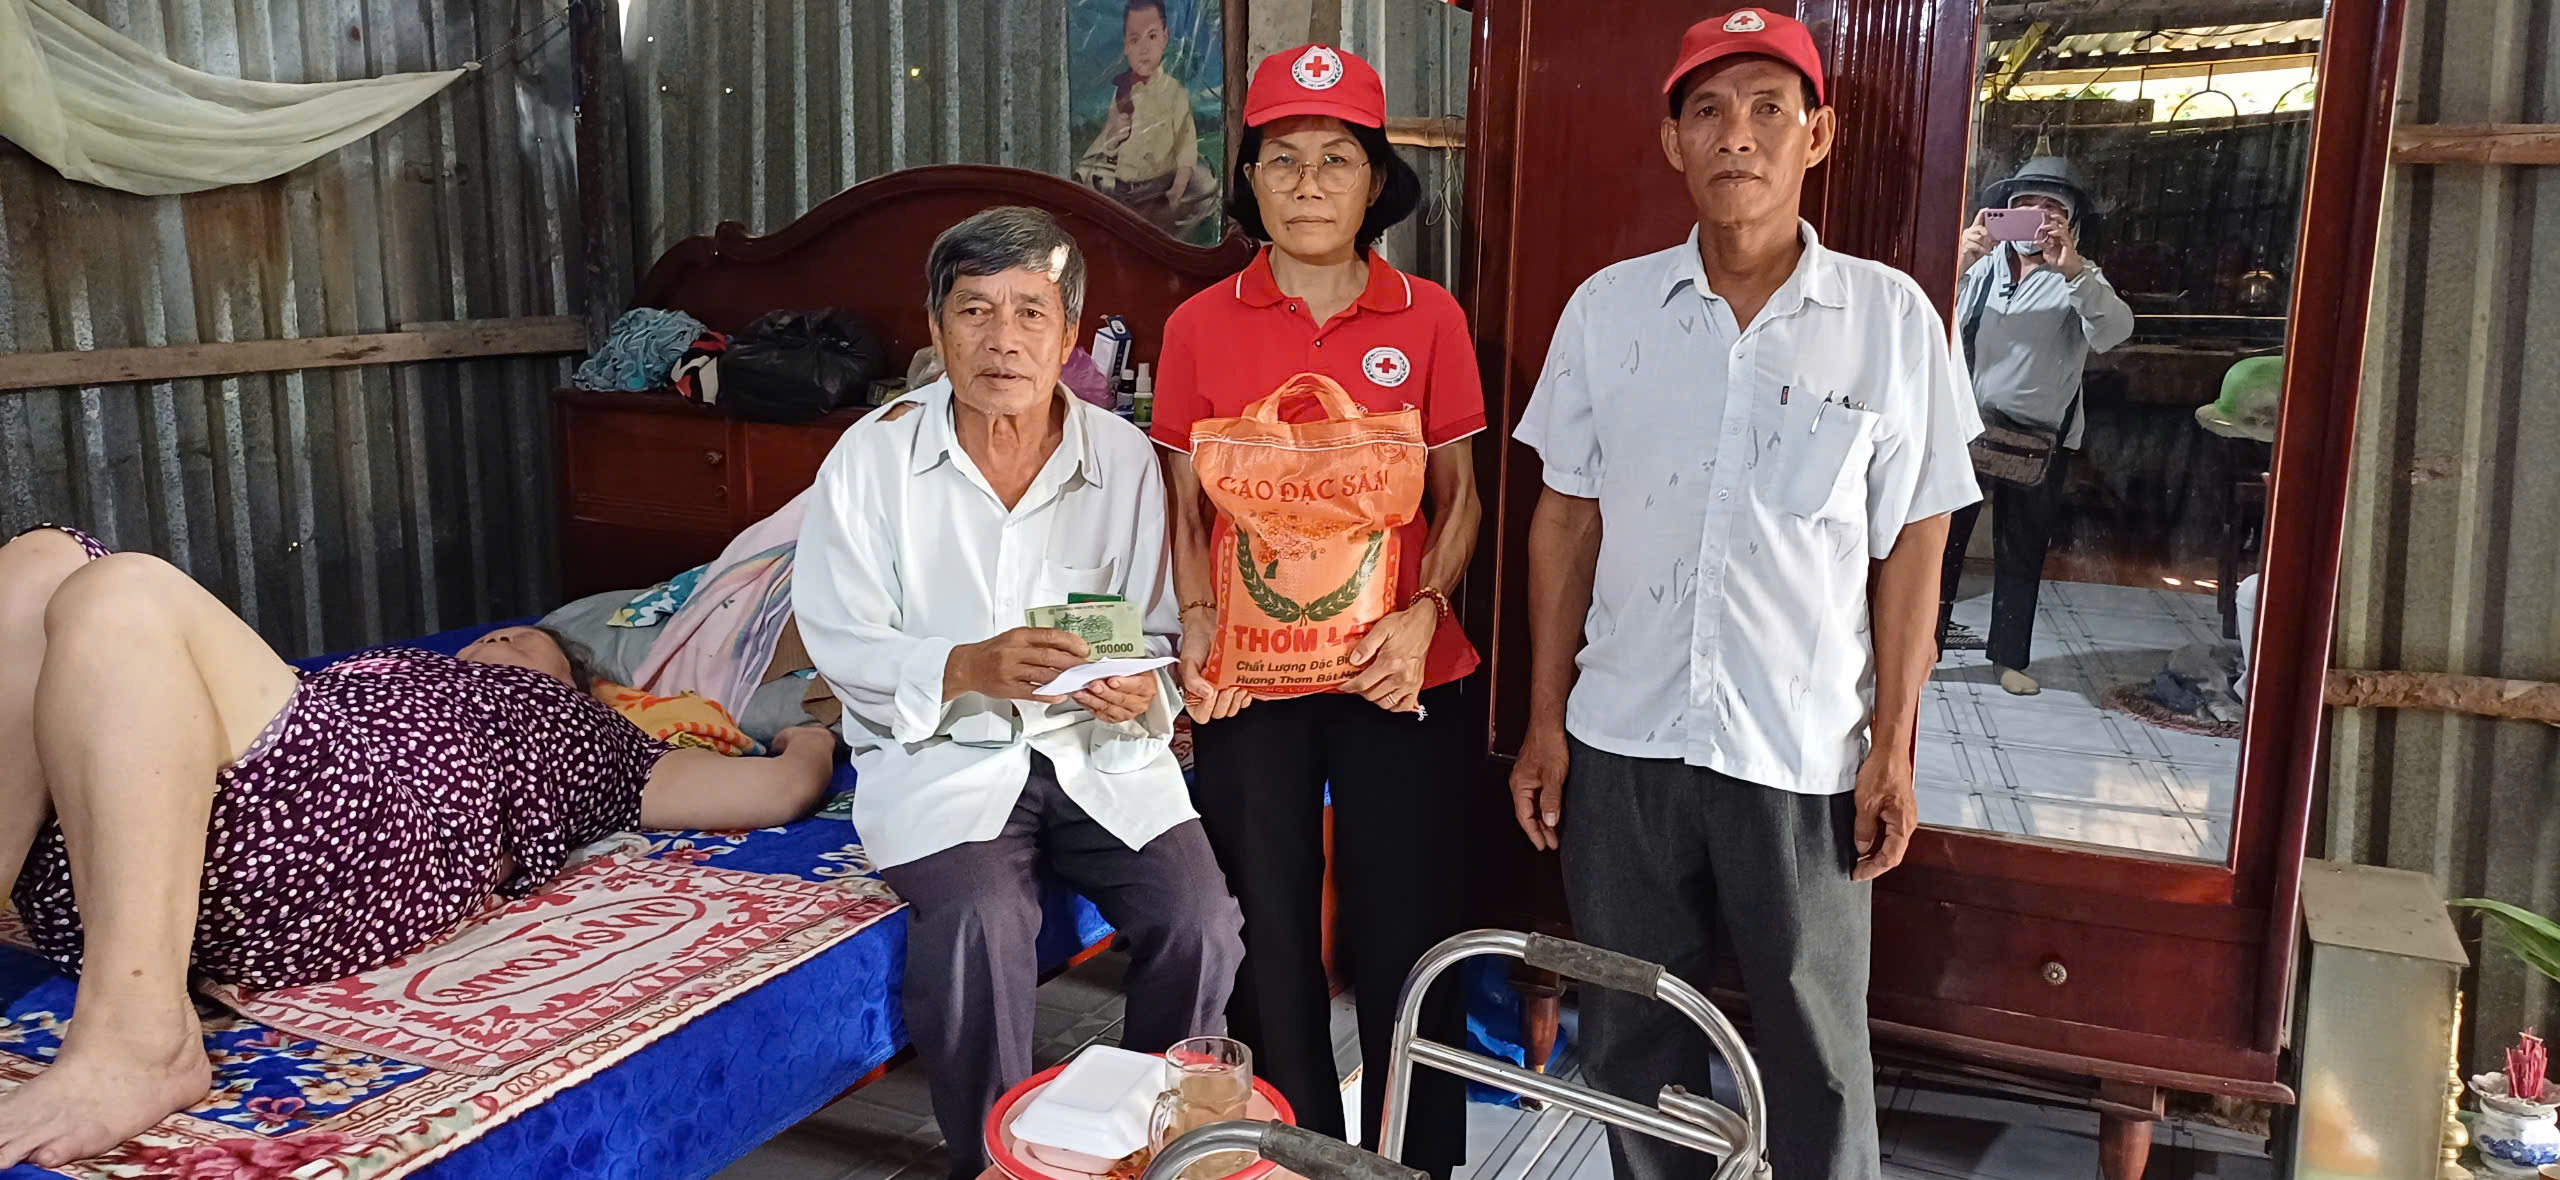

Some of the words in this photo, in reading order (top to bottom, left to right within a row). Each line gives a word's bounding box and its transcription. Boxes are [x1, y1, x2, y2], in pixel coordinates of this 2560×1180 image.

[1280, 478, 1336, 505] ĐẶC
[1233, 624, 1318, 654] THƠM
[1236, 659, 1265, 672] Chất
